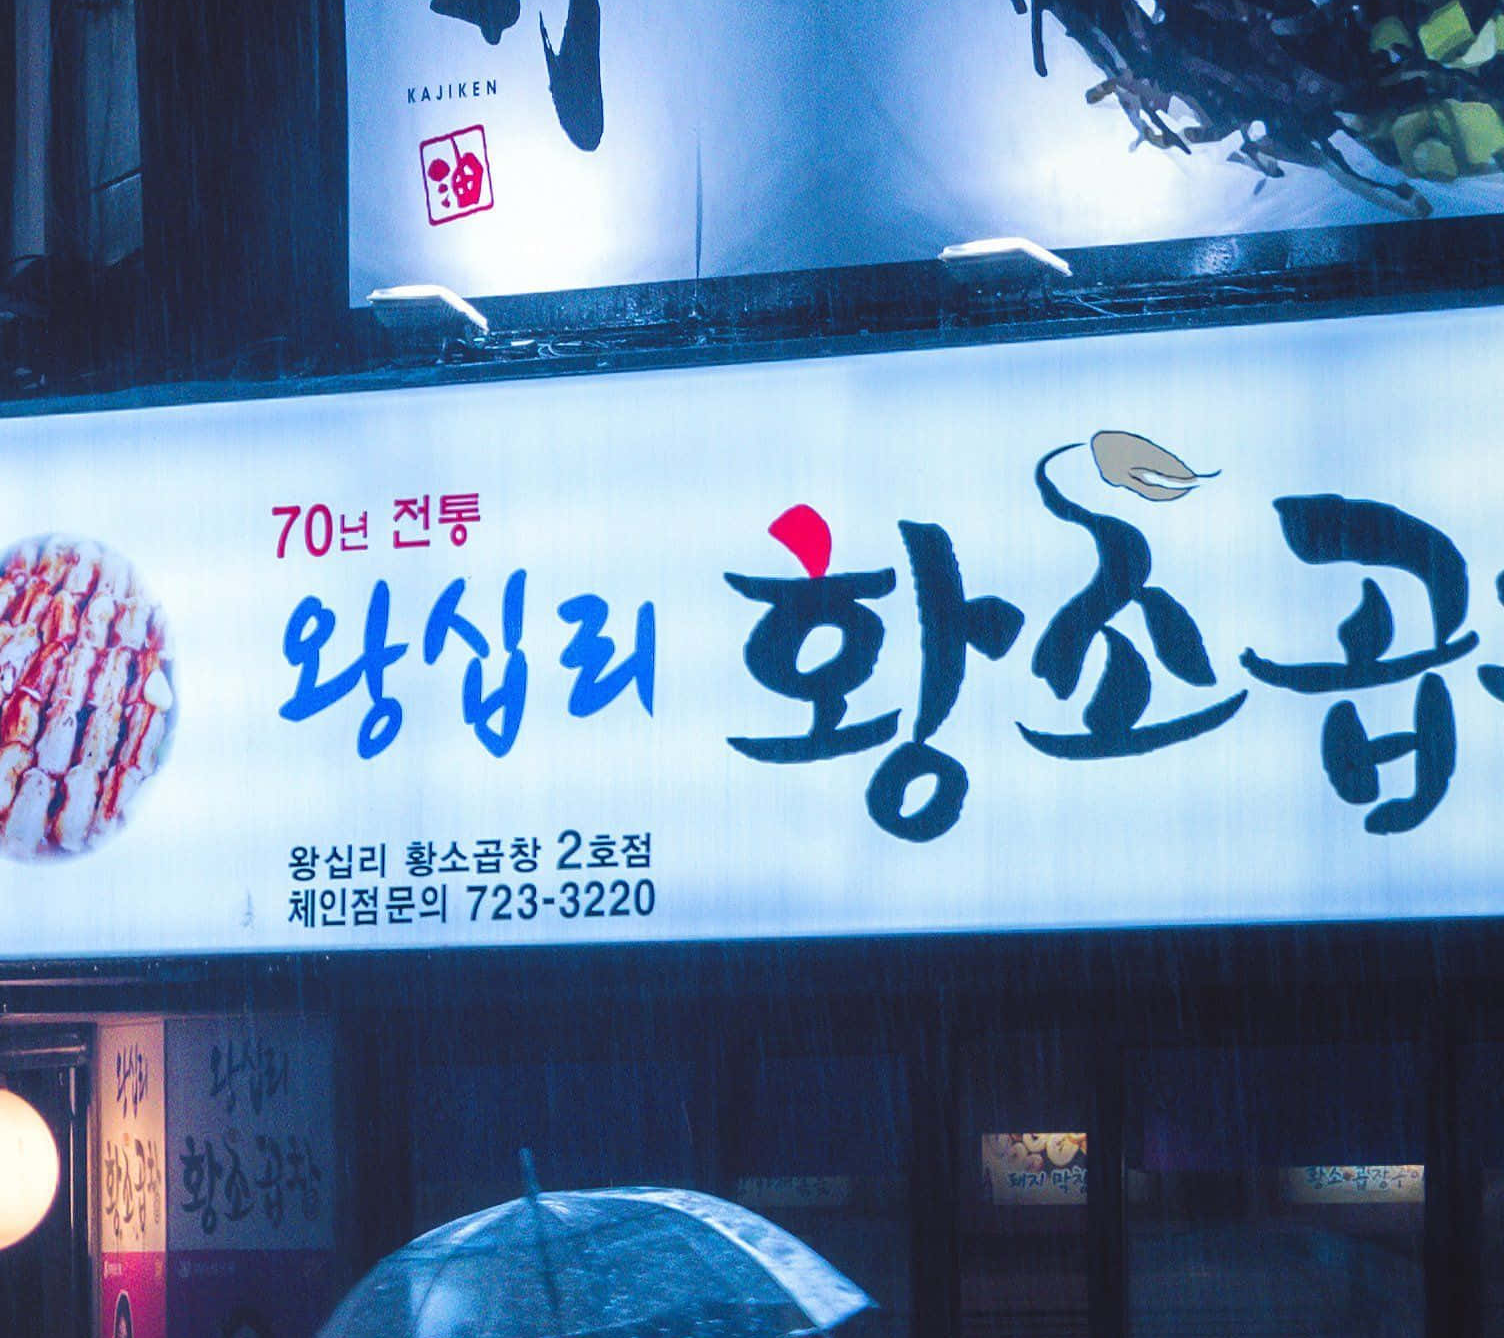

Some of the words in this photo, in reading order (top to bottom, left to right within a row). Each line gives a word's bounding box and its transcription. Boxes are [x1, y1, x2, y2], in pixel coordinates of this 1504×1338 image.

[406, 79, 499, 103] KAJIKEN
[271, 503, 372, 559] 70년
[392, 491, 483, 552] 전통
[277, 567, 658, 761] 왕십리
[724, 444, 1504, 843] 황소곱
[287, 841, 388, 882] 왕십리
[404, 835, 543, 878] 황소곱창
[555, 828, 654, 873] 2호점
[287, 885, 449, 932] 체인점문의
[465, 879, 656, 925] 723-3220
